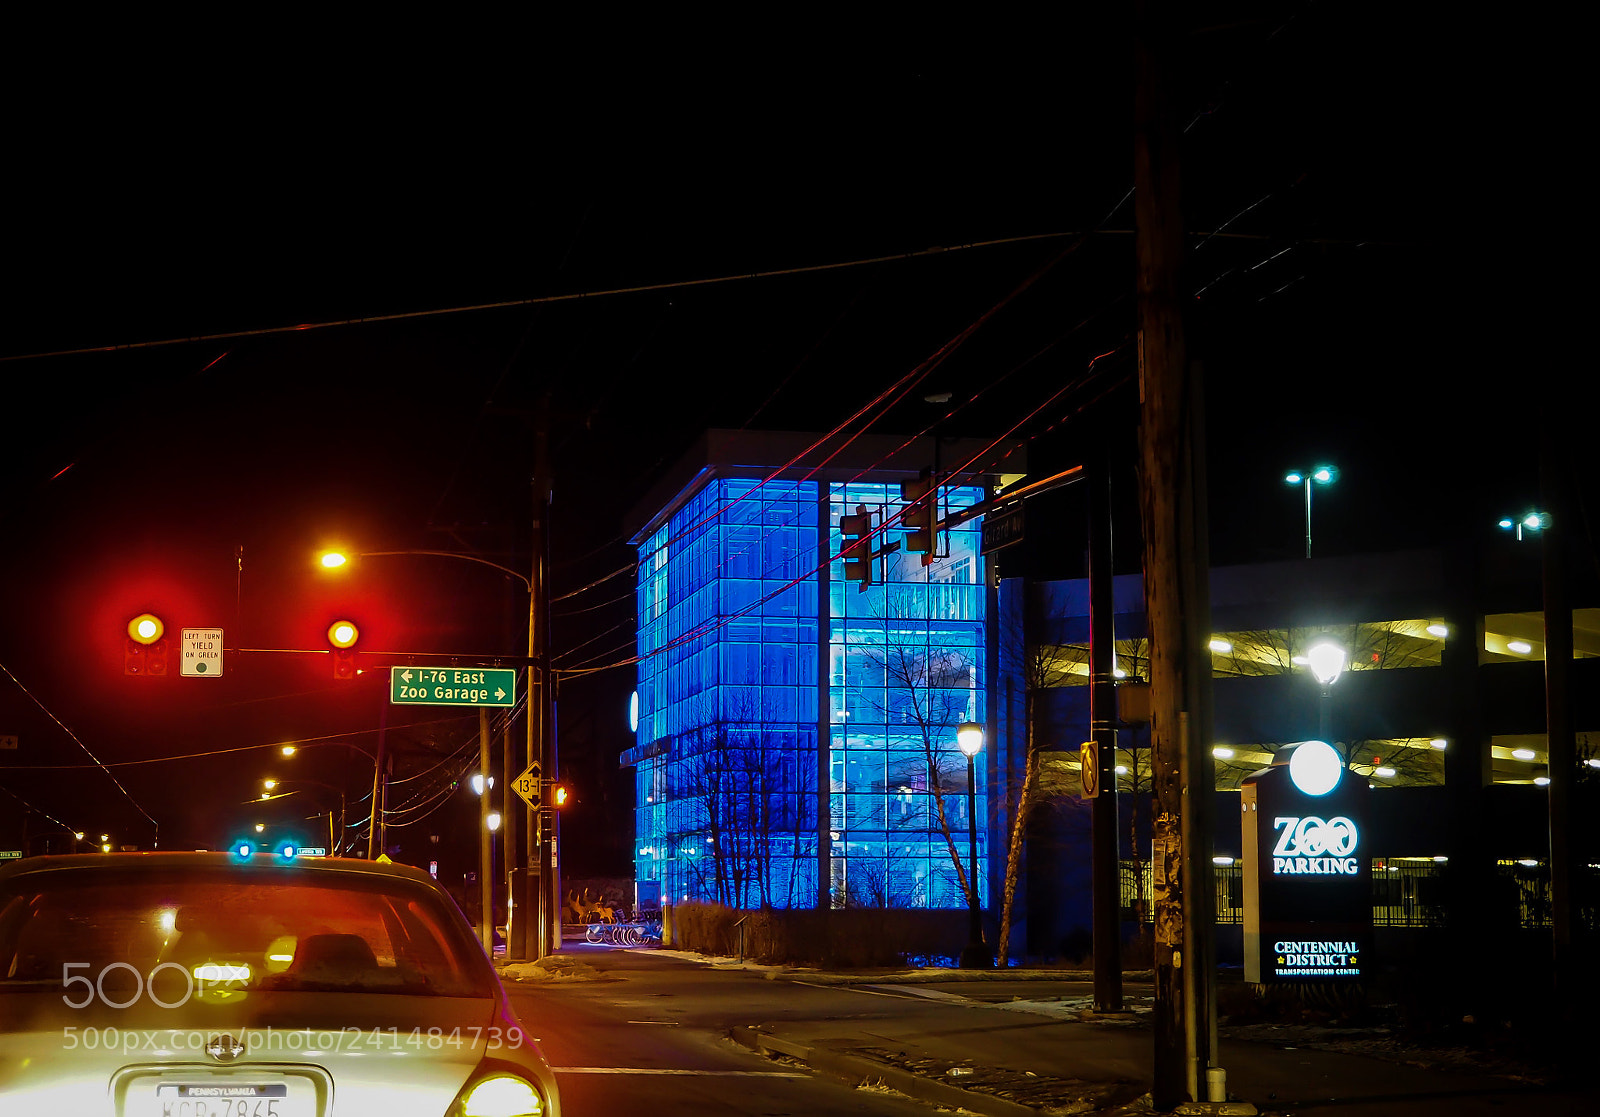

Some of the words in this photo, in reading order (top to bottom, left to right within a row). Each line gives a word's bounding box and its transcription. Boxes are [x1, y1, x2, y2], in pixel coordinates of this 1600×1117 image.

[184, 632, 199, 640] LEFT
[204, 632, 221, 640] TURN
[191, 641, 213, 650] YIELD
[185, 651, 195, 659] ON
[198, 651, 219, 659] GREEN
[419, 671, 447, 684] I-76
[454, 671, 485, 685] East
[400, 685, 428, 699] Zoo
[434, 686, 488, 703] Garage
[1272, 815, 1358, 858] ZOO
[1272, 857, 1359, 875] PARKING
[1274, 941, 1360, 954] CENTENNIAL
[1286, 953, 1349, 966] DISTRICT
[1275, 968, 1335, 976] TRANSPORTATION
[1335, 968, 1360, 976] CENTER
[189, 1086, 256, 1096] PENNSYLVANIA
